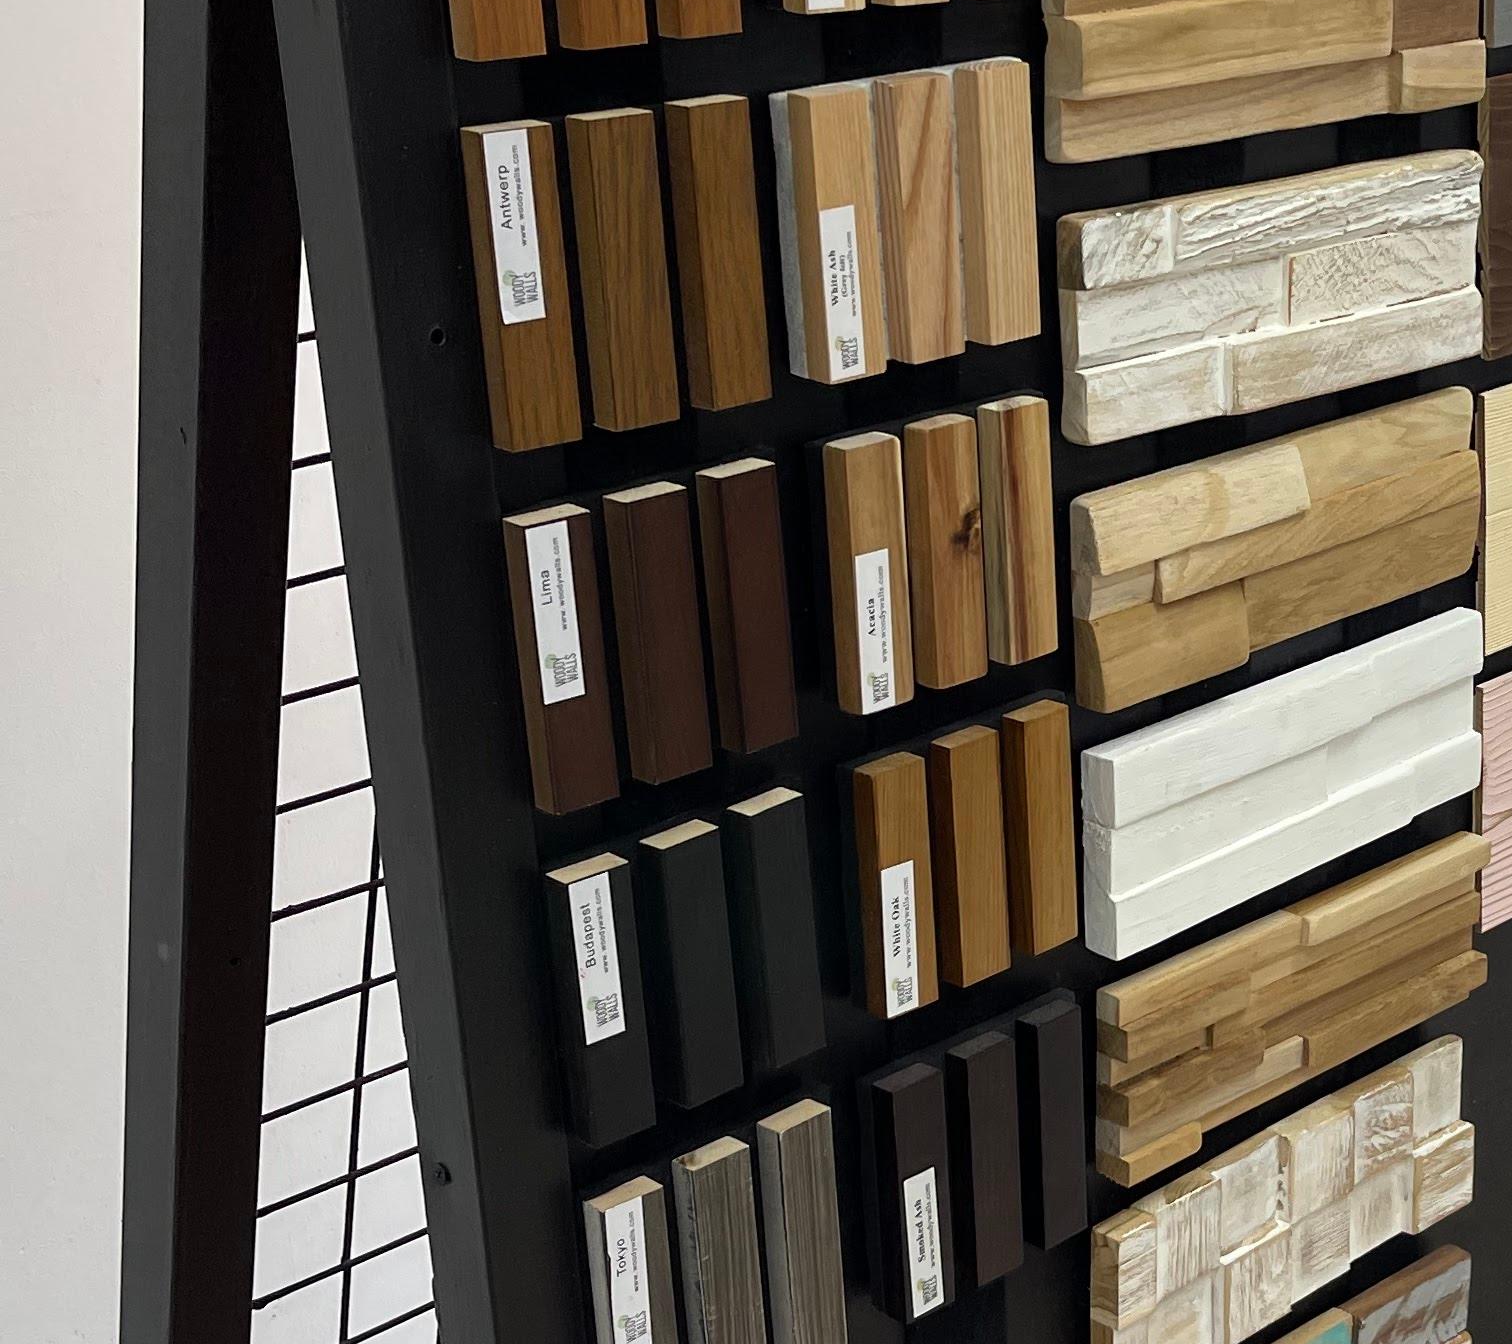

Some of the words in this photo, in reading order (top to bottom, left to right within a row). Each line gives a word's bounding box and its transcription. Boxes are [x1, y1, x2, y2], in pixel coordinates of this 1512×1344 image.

[496, 165, 513, 230] Antwerp
[828, 250, 837, 270] Ash
[511, 273, 525, 306] WOODY
[523, 271, 538, 303] WALLS
[830, 273, 839, 306] White
[840, 336, 851, 369] WOODY
[848, 337, 859, 366] WALLS
[540, 570, 553, 605] Lima
[867, 598, 877, 637] Acacia
[552, 656, 565, 687] WOODY
[563, 653, 578, 683] WALLS
[872, 673, 881, 703] WOODY
[879, 673, 889, 700] WALLS
[891, 896, 900, 920] Oak
[580, 902, 597, 968] Budapest
[892, 923, 901, 957] White
[895, 978, 906, 1007] WOODY
[903, 977, 913, 1002] WALLS
[593, 998, 607, 1026] WOODY
[605, 993, 619, 1021] WALLS
[914, 1199, 923, 1218] Ash
[915, 1221, 927, 1262] Smoked
[616, 1238, 628, 1277] Tokyo
[623, 1315, 637, 1343] WOODY
[634, 1311, 647, 1336] WALLS
